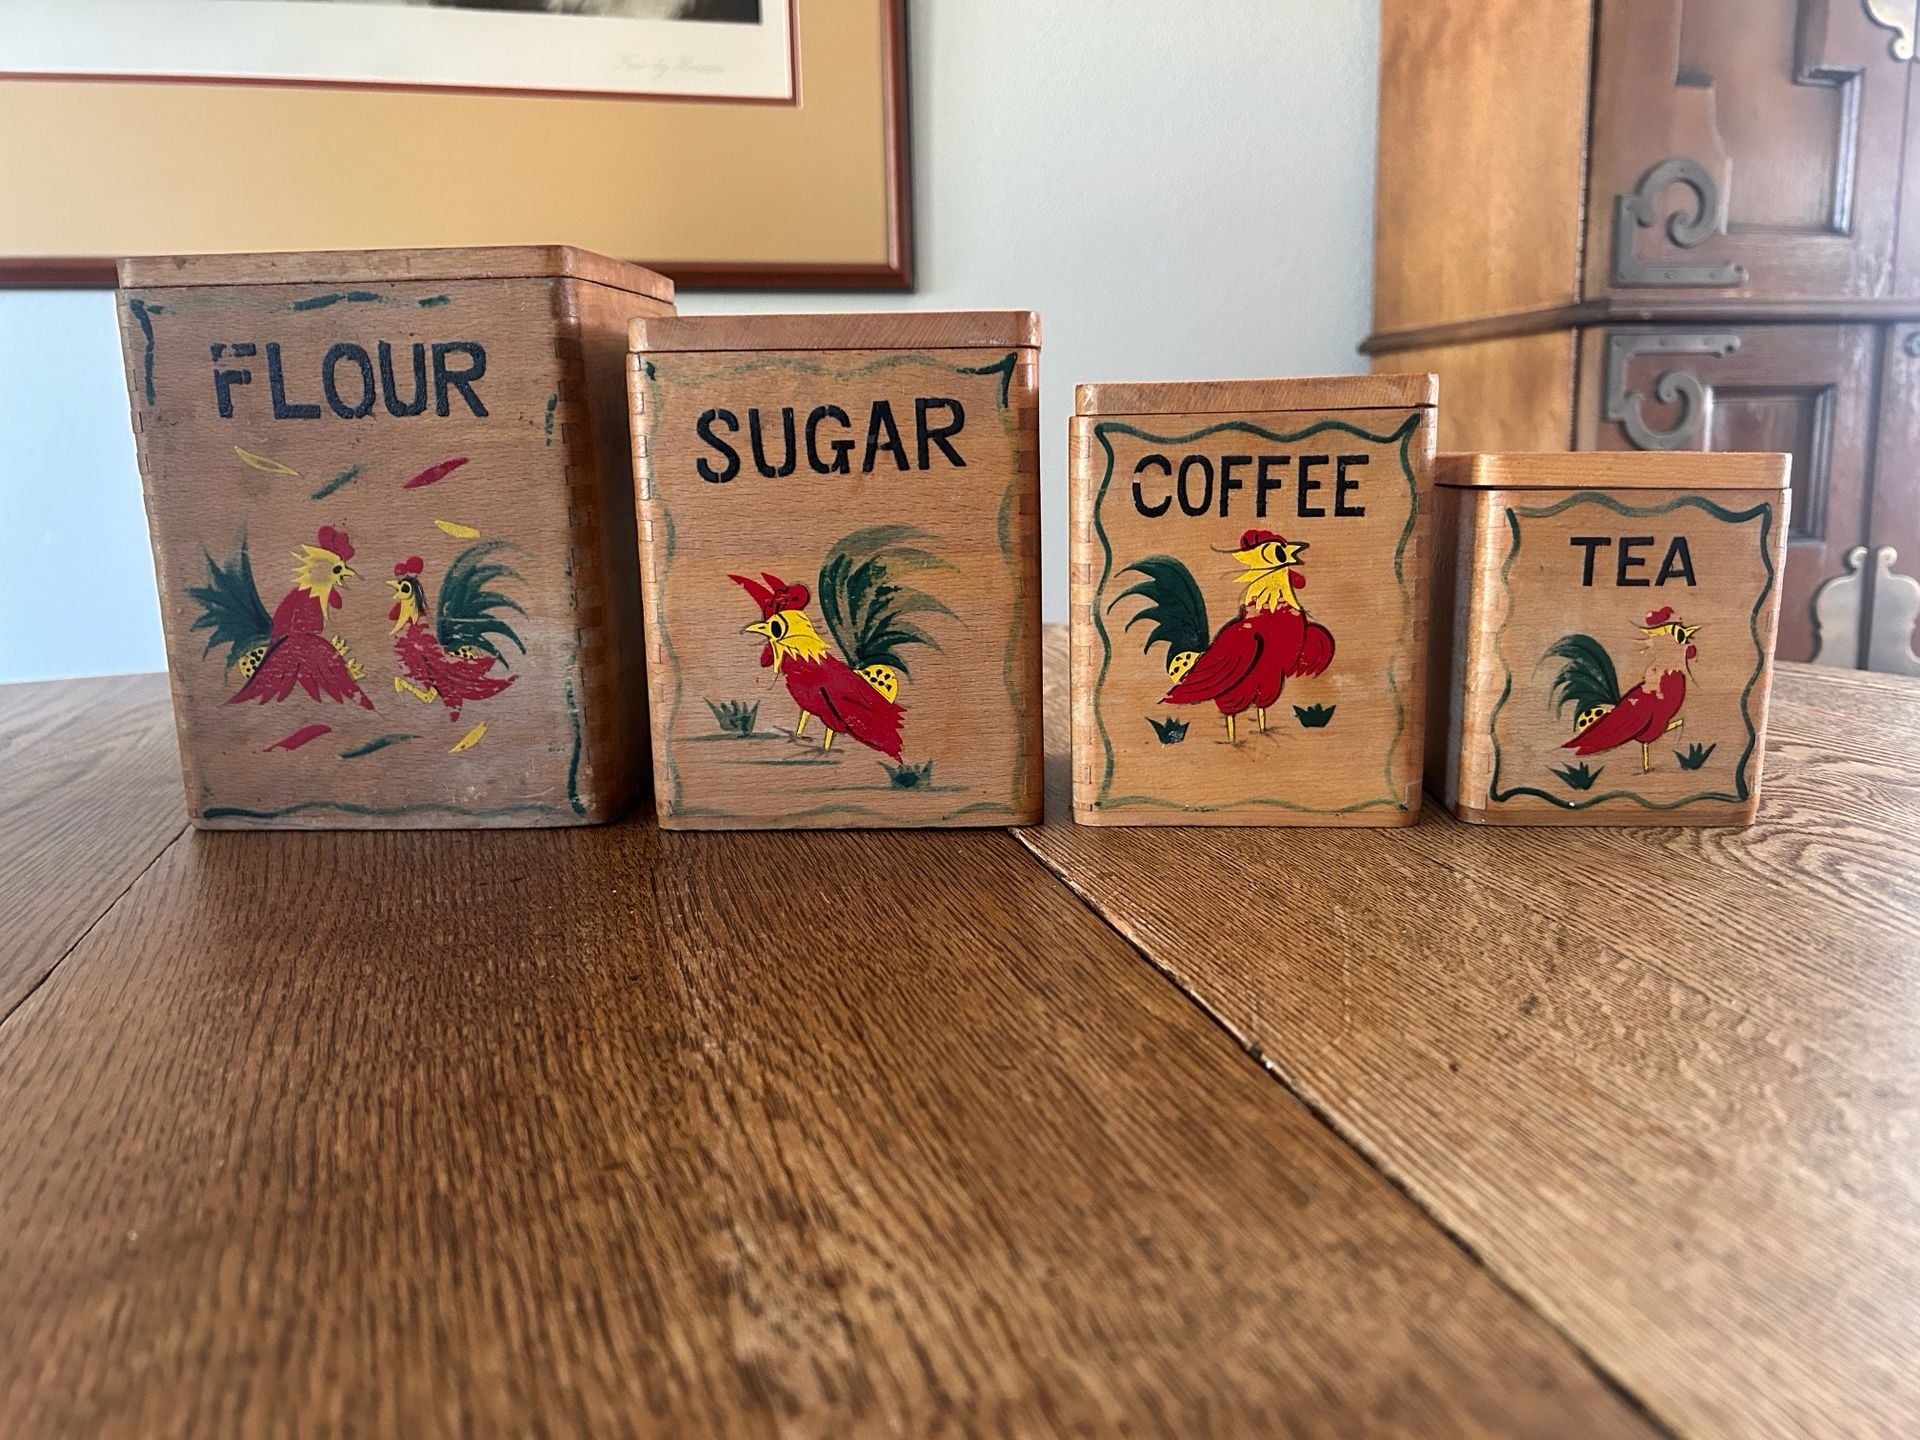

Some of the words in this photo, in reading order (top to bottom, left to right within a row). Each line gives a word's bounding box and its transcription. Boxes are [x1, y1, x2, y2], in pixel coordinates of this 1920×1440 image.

[211, 340, 489, 420] FLOUR
[696, 397, 966, 484] SUGAR
[1132, 453, 1370, 518] COFFEE
[1570, 535, 1697, 588] TEA
